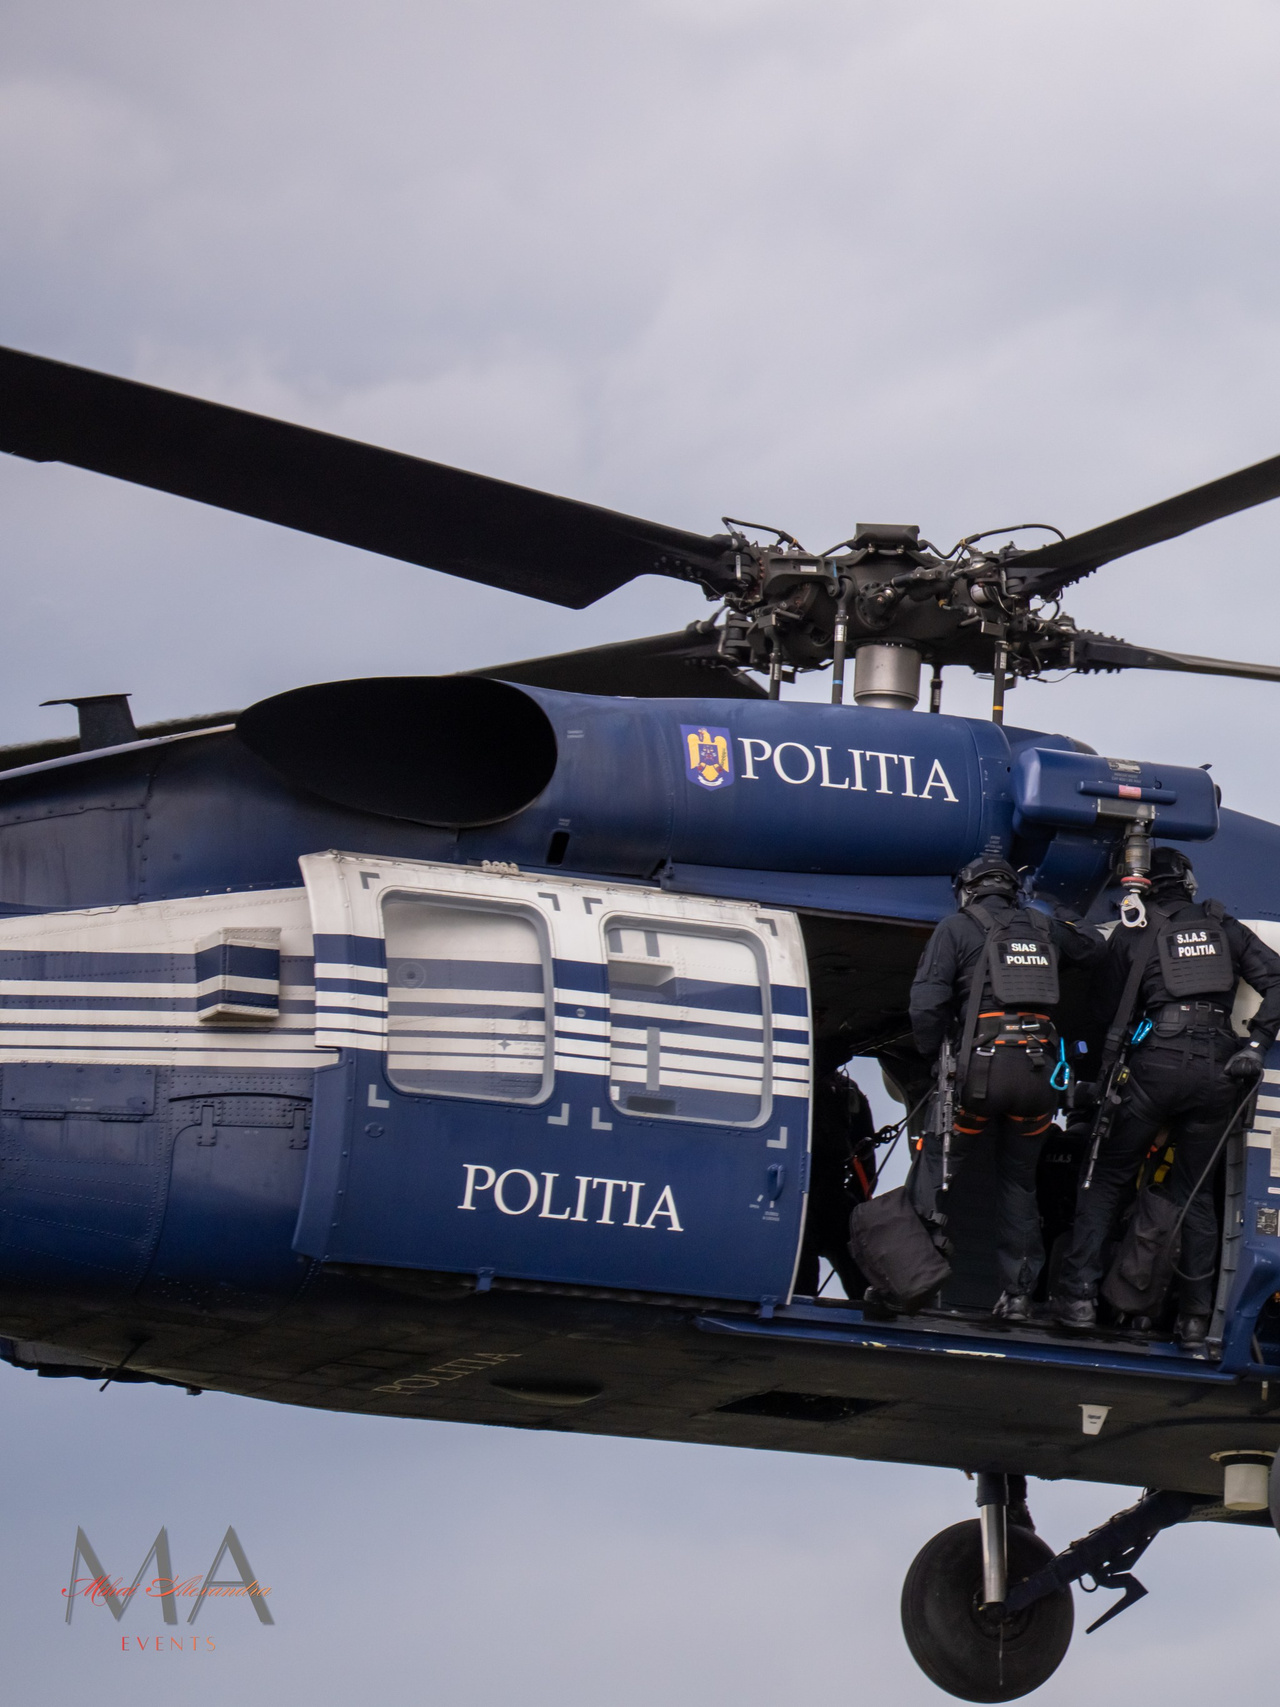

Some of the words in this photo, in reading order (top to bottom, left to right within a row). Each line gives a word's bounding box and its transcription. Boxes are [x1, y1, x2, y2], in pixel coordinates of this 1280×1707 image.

[737, 737, 959, 802] POLITIA
[1177, 932, 1207, 944] S.I.A.S
[1011, 943, 1037, 952] SIAS
[1178, 944, 1216, 957] POLITIA
[1006, 956, 1048, 966] POLITIA
[457, 1164, 684, 1232] POLITIA
[373, 1353, 523, 1396] POLITIA
